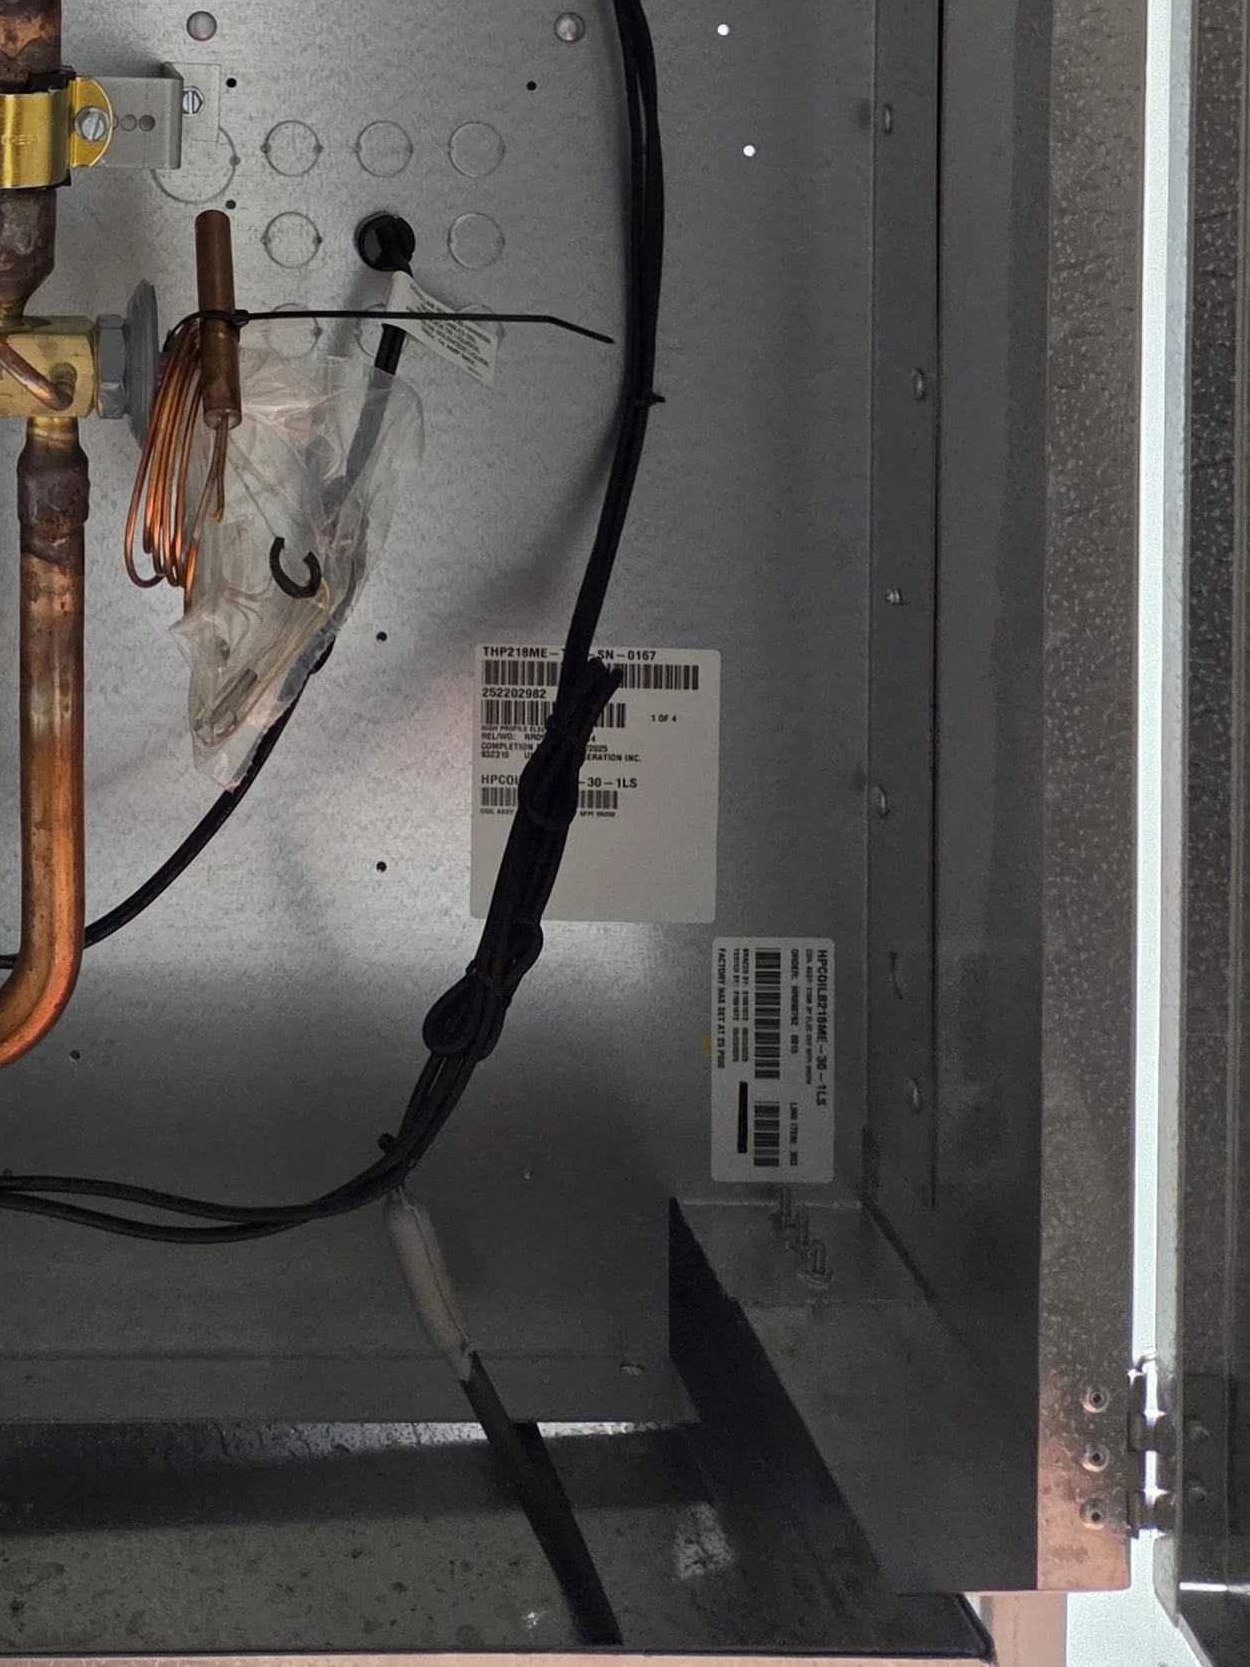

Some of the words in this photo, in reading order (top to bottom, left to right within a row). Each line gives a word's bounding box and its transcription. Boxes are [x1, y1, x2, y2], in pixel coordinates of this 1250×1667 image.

[482, 687, 546, 698] 252202982
[481, 742, 533, 751] COMPLETION
[625, 754, 641, 762] INC.
[717, 948, 726, 984] FACTORY
[717, 1006, 726, 1021] SET
[717, 1024, 725, 1034] AT
